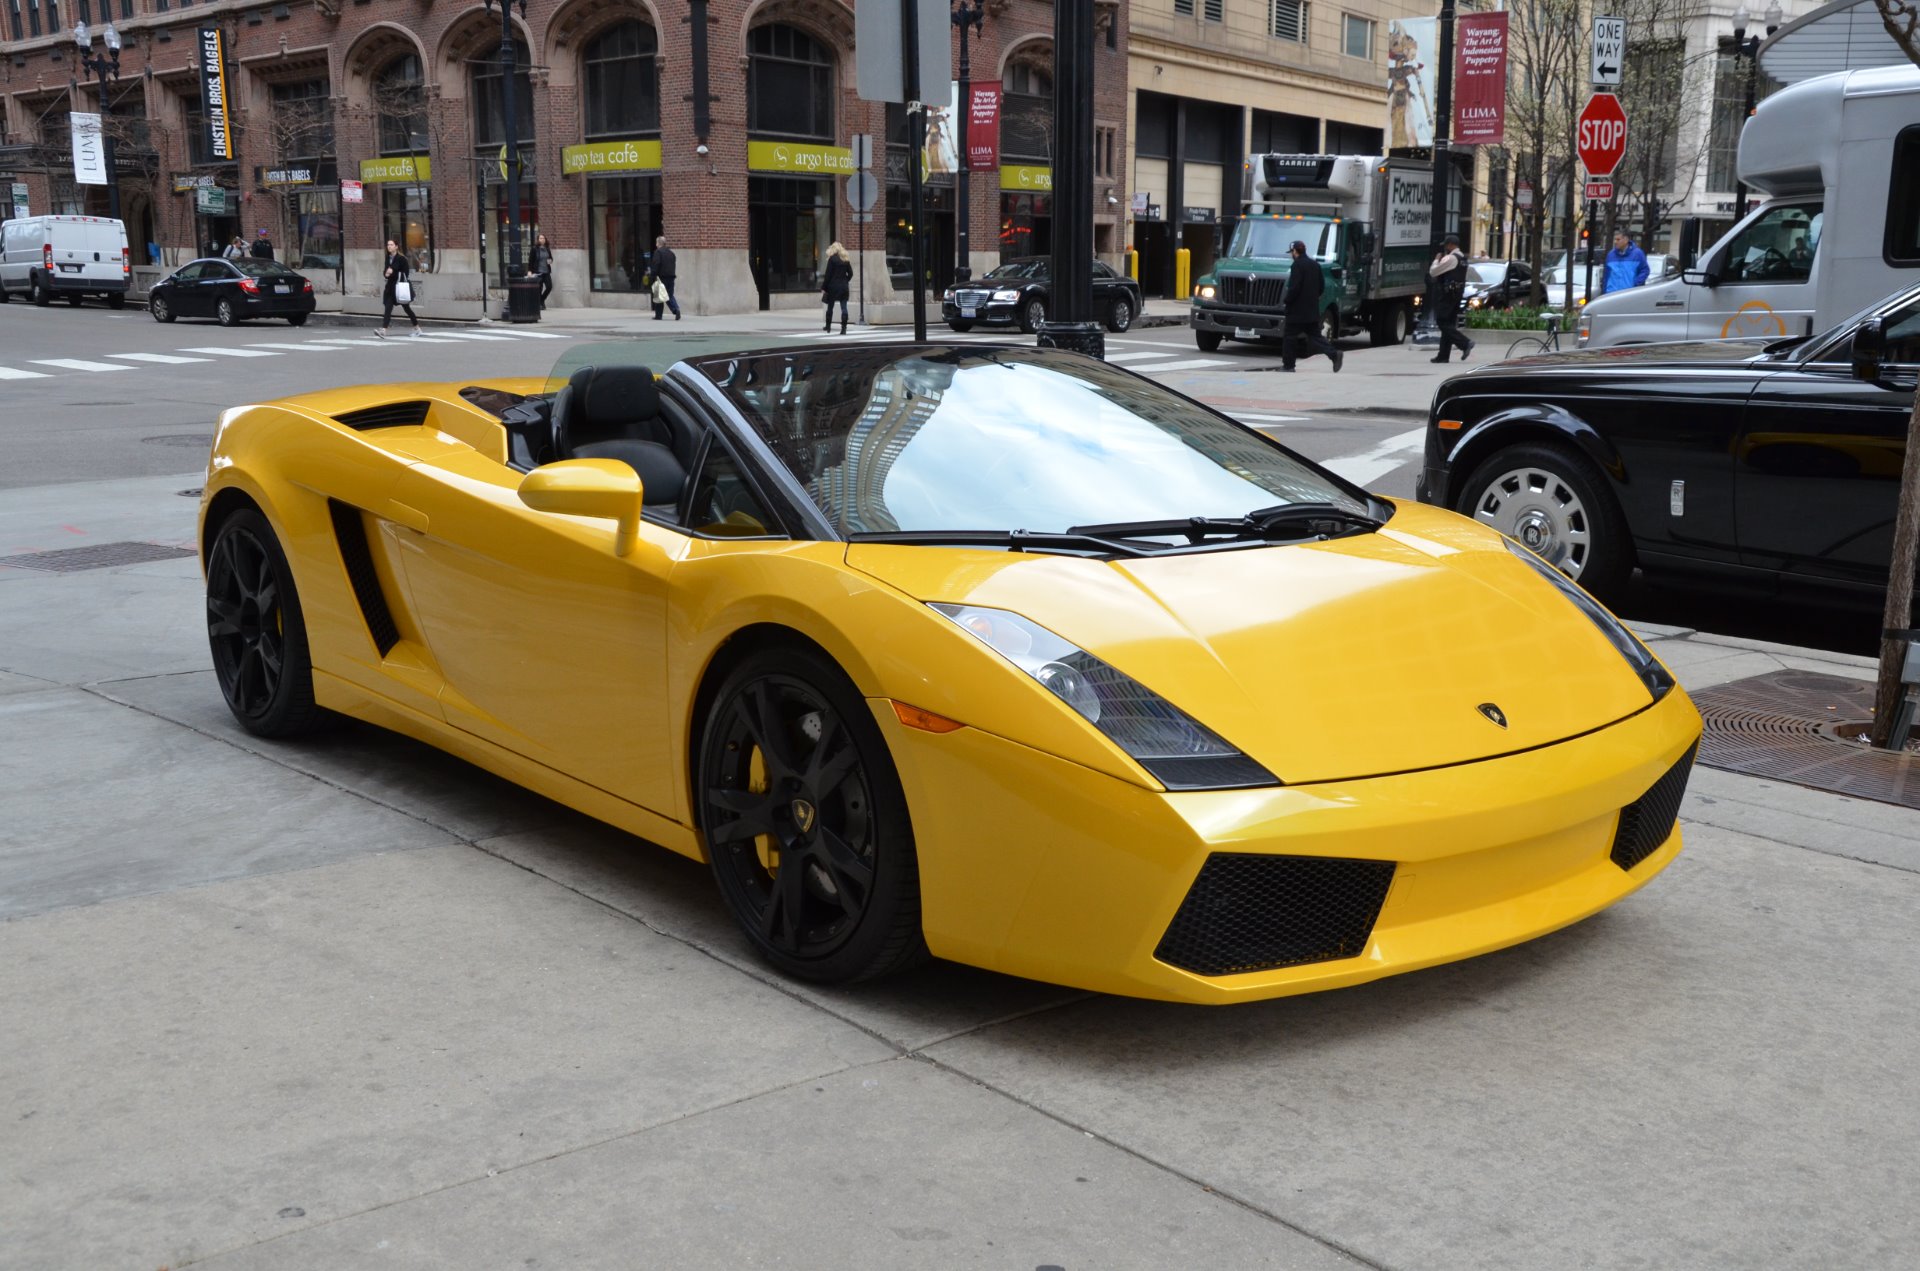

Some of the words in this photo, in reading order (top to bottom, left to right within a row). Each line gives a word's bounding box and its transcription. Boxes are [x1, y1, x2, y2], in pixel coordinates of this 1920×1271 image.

[1466, 28, 1500, 38] Wayang:
[1597, 23, 1621, 39] ONE
[1465, 37, 1478, 46] The
[1479, 37, 1492, 45] Art
[1493, 35, 1502, 46] of
[203, 31, 220, 72] BAGELS
[1462, 46, 1503, 55] Indonesian
[1596, 42, 1620, 58] WAY
[1465, 56, 1499, 66] Puppetry
[208, 75, 223, 105] BROS.
[1462, 107, 1497, 119] LUMA
[211, 107, 226, 156] EINSTEIN
[1580, 119, 1624, 150] STOP
[571, 154, 588, 170] argo
[590, 150, 604, 165] tea
[608, 143, 638, 163] café
[795, 152, 822, 170] argo
[824, 152, 837, 167] tea
[292, 169, 310, 181] BAGELS
[375, 164, 387, 177] tea
[389, 159, 413, 176] café
[1034, 173, 1052, 188] arg
[1587, 186, 1598, 196] ALL
[1599, 186, 1611, 195] WAY
